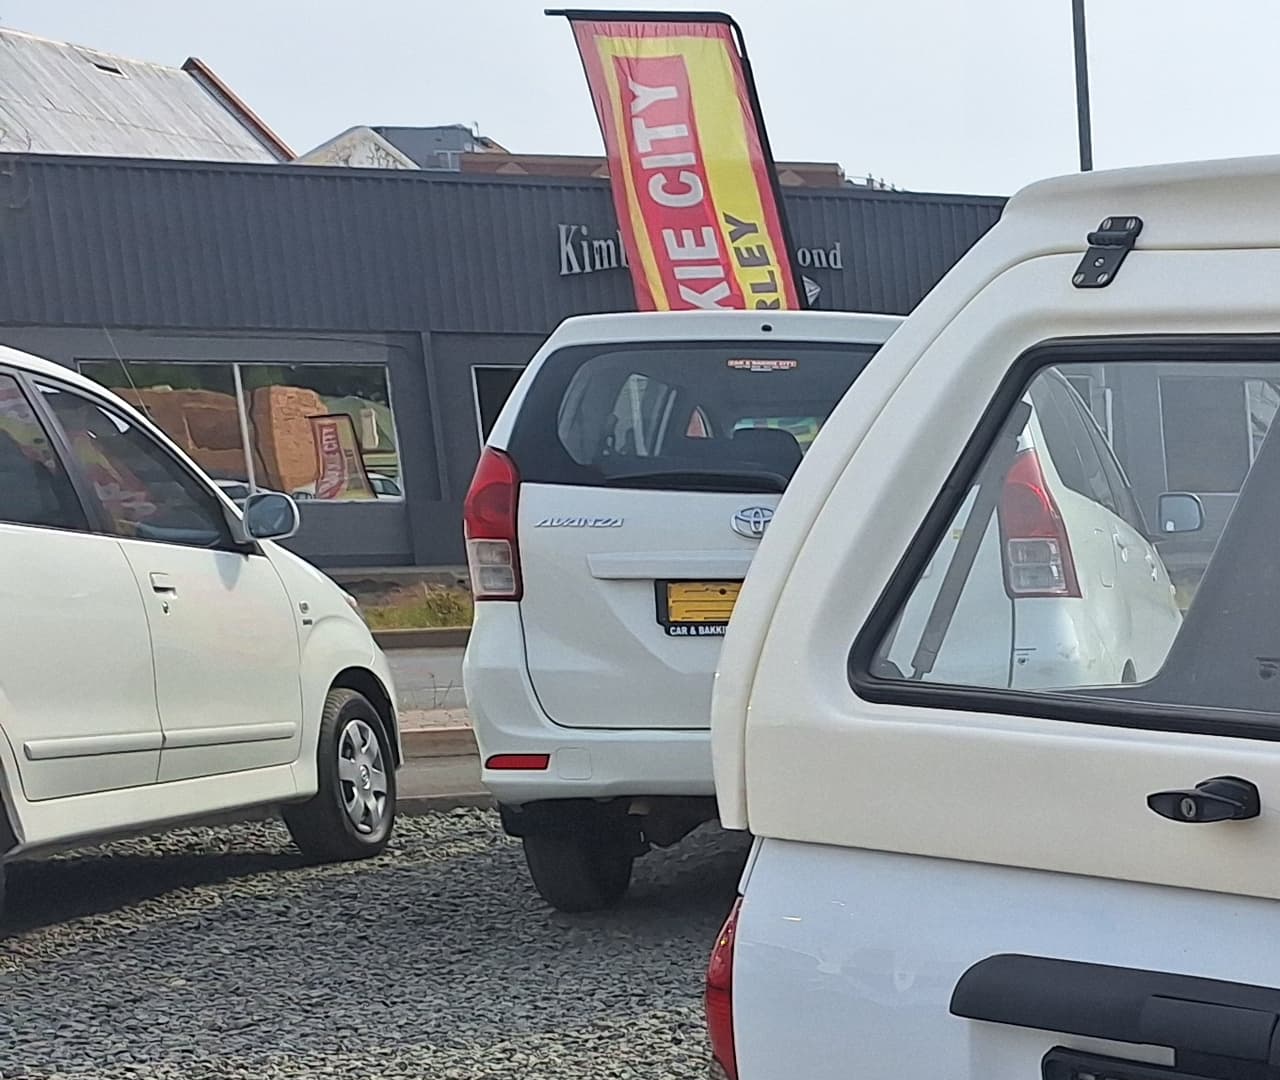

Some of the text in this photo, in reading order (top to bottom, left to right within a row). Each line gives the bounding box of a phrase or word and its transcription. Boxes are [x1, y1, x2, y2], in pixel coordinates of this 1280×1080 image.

[627, 77, 704, 208] CITY
[558, 223, 629, 276] Kim
[534, 517, 625, 529] AVANZA
[669, 625, 727, 635] CAR & BAKKI
